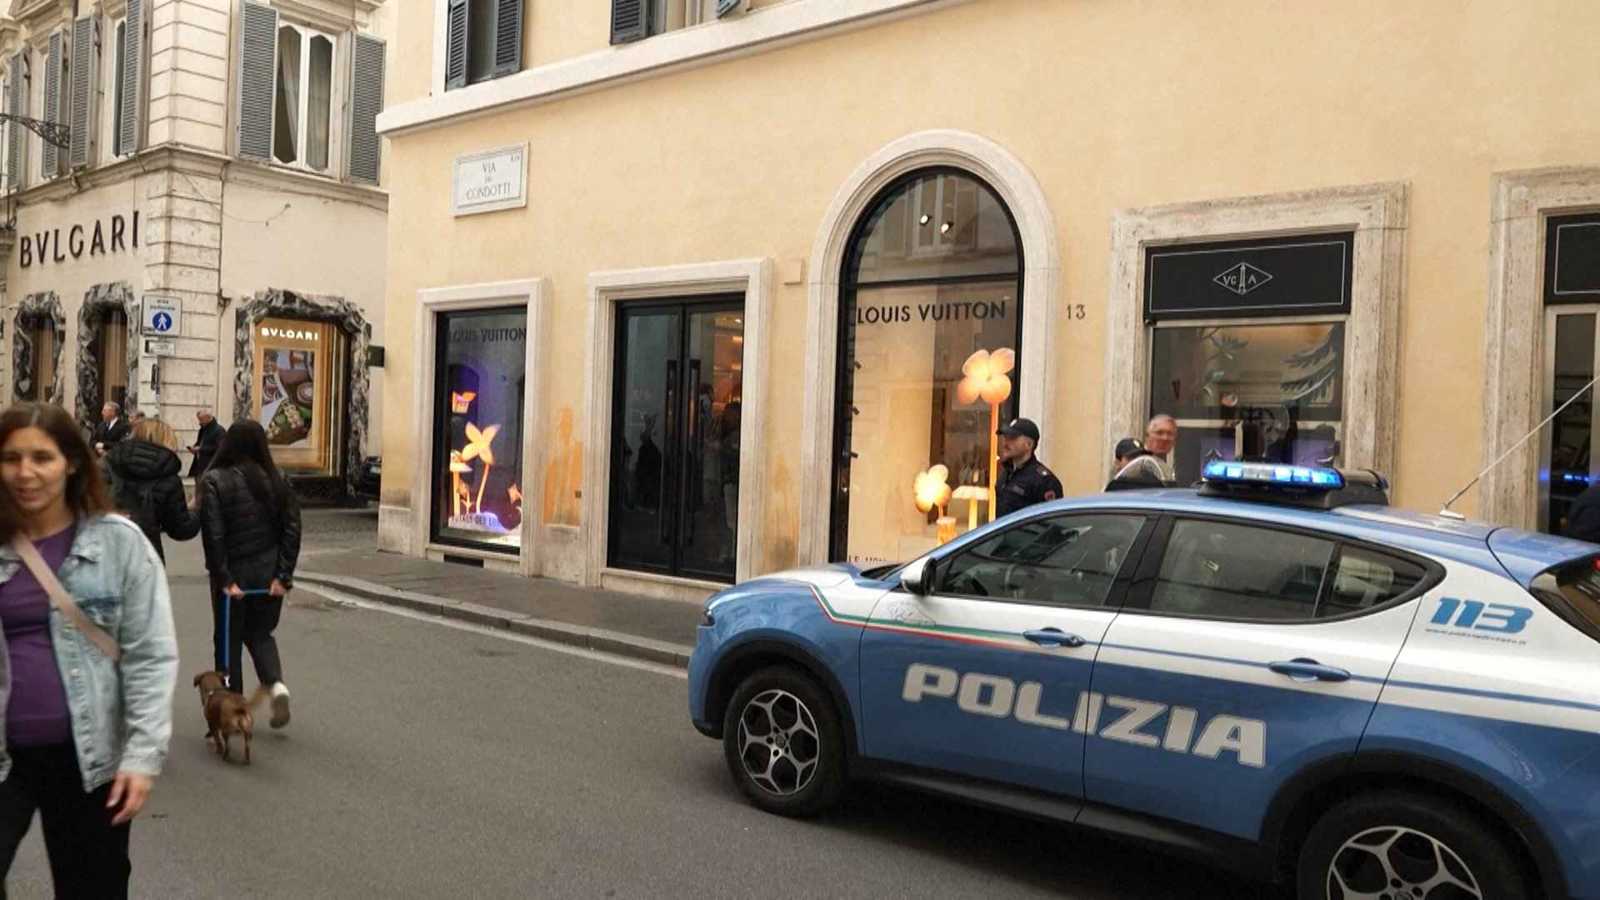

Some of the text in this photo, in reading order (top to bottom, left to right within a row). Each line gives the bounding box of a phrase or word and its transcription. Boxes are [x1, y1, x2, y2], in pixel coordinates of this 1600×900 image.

[482, 161, 497, 173] VIA
[19, 210, 139, 268] BVLGARI
[857, 301, 1006, 324] LOUIS VUITTON
[1066, 305, 1086, 320] 13
[481, 327, 527, 342] VUITTON
[1430, 597, 1534, 634] 113
[902, 662, 1268, 768] POLIZIA
